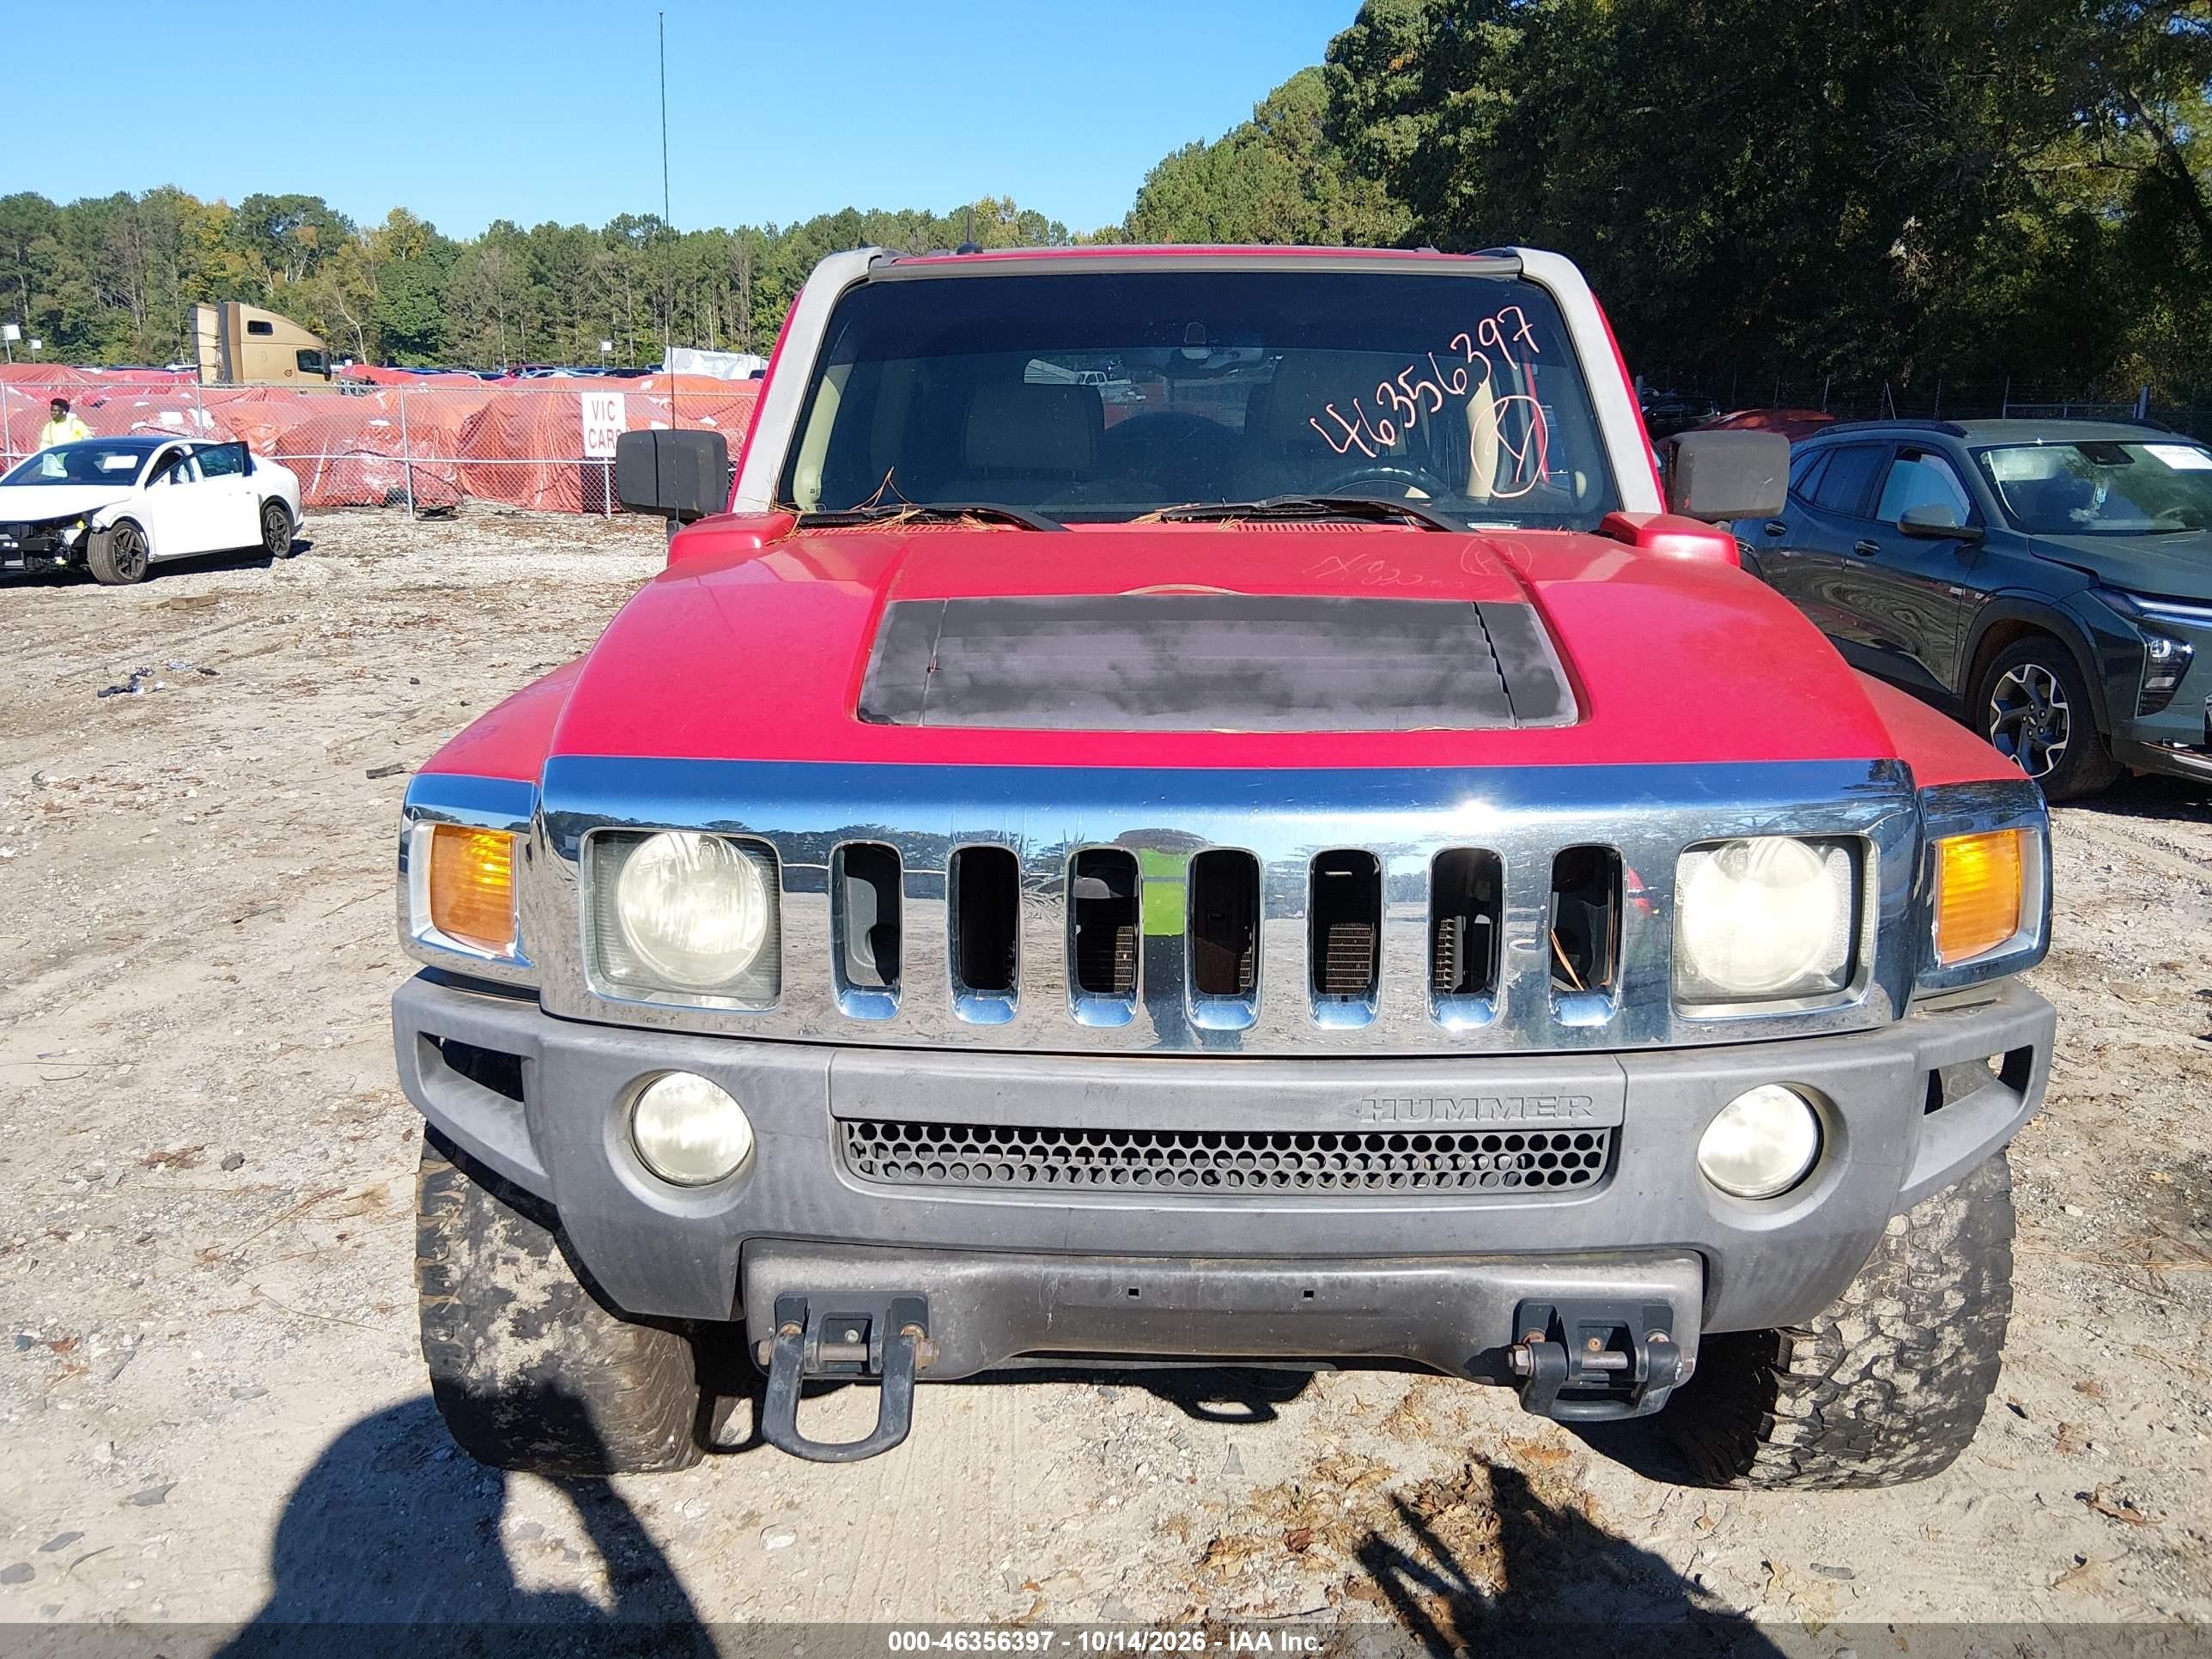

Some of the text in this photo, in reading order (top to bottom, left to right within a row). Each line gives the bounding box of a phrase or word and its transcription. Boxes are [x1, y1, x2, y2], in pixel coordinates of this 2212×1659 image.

[1310, 306, 1540, 458] 46356397
[591, 400, 616, 422] VIC
[1360, 1096, 1594, 1122] HUMMER
